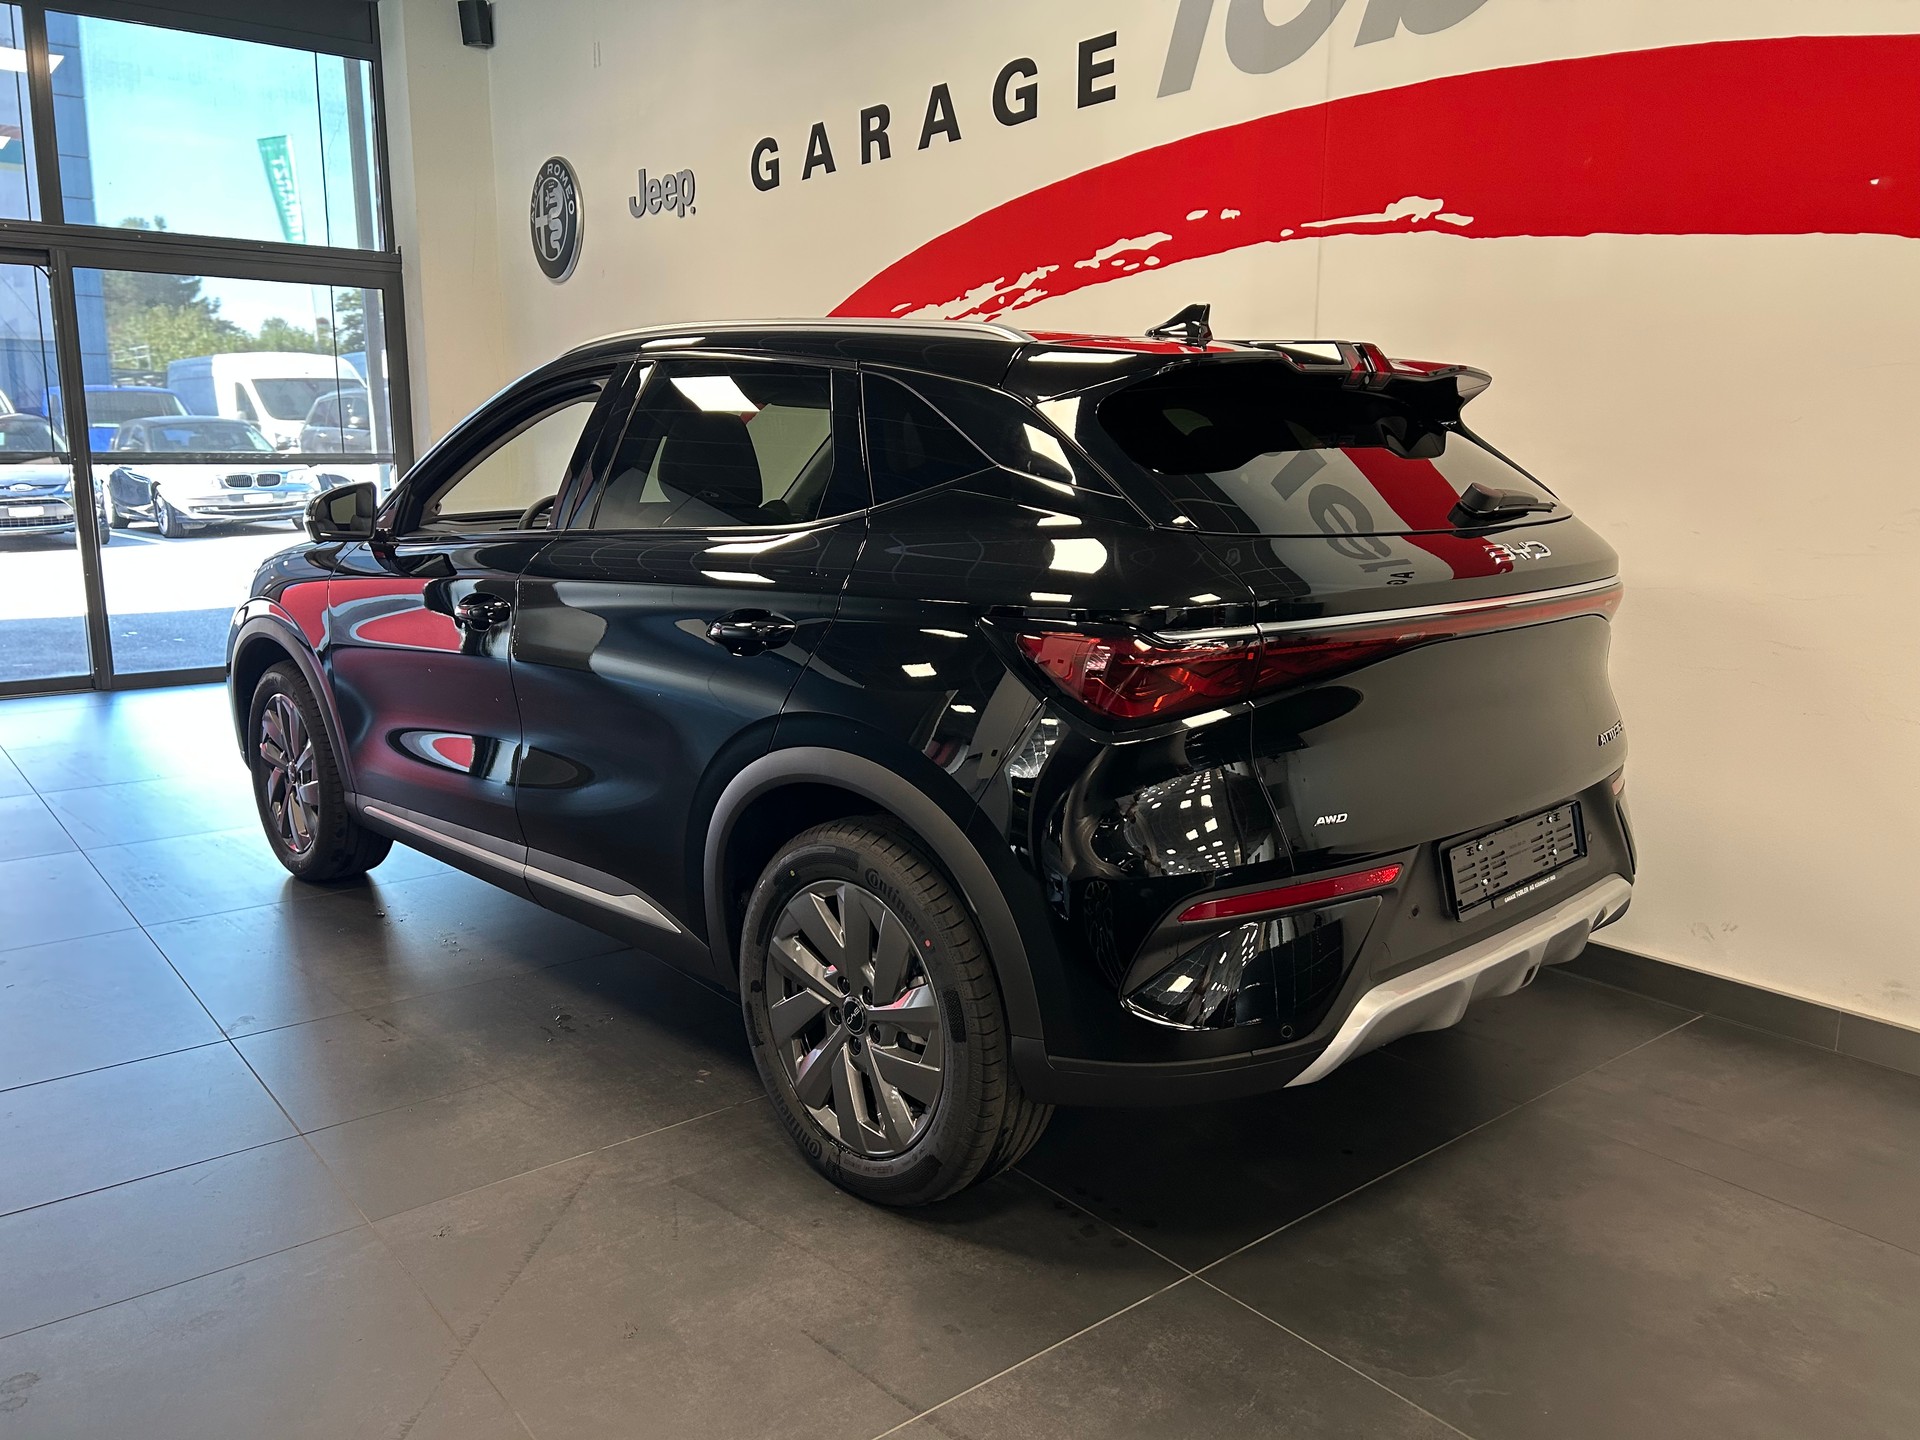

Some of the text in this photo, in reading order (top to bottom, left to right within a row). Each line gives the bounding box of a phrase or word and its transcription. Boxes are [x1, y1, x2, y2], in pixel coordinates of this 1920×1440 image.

[751, 31, 1117, 191] GARAGE
[531, 163, 575, 224] ALFA ROMEO
[1483, 540, 1552, 565] BYD
[1314, 813, 1348, 827] AWD
